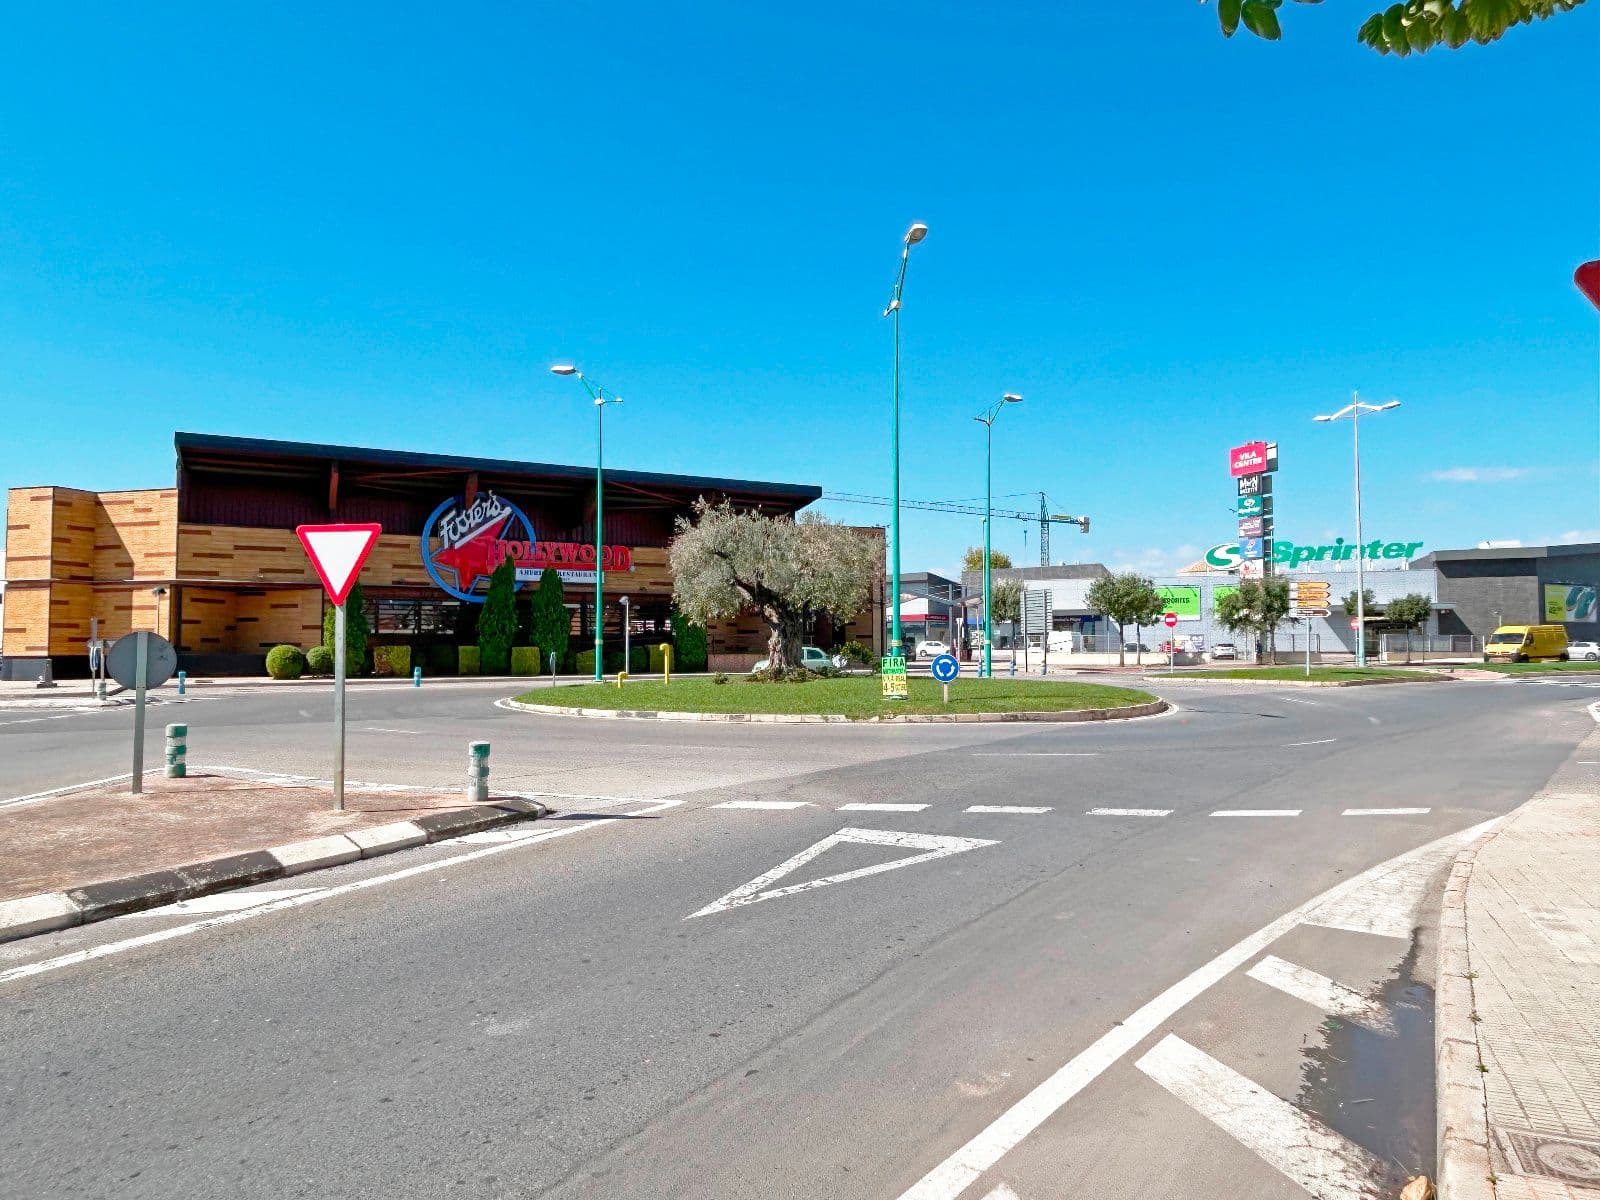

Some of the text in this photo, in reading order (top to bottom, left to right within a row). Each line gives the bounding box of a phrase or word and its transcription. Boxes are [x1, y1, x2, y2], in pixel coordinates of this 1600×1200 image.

[1239, 451, 1256, 460] VILA
[485, 539, 632, 572] HOLLYWOOD
[1272, 538, 1424, 568] Sprinter
[883, 658, 905, 667] FIRA
